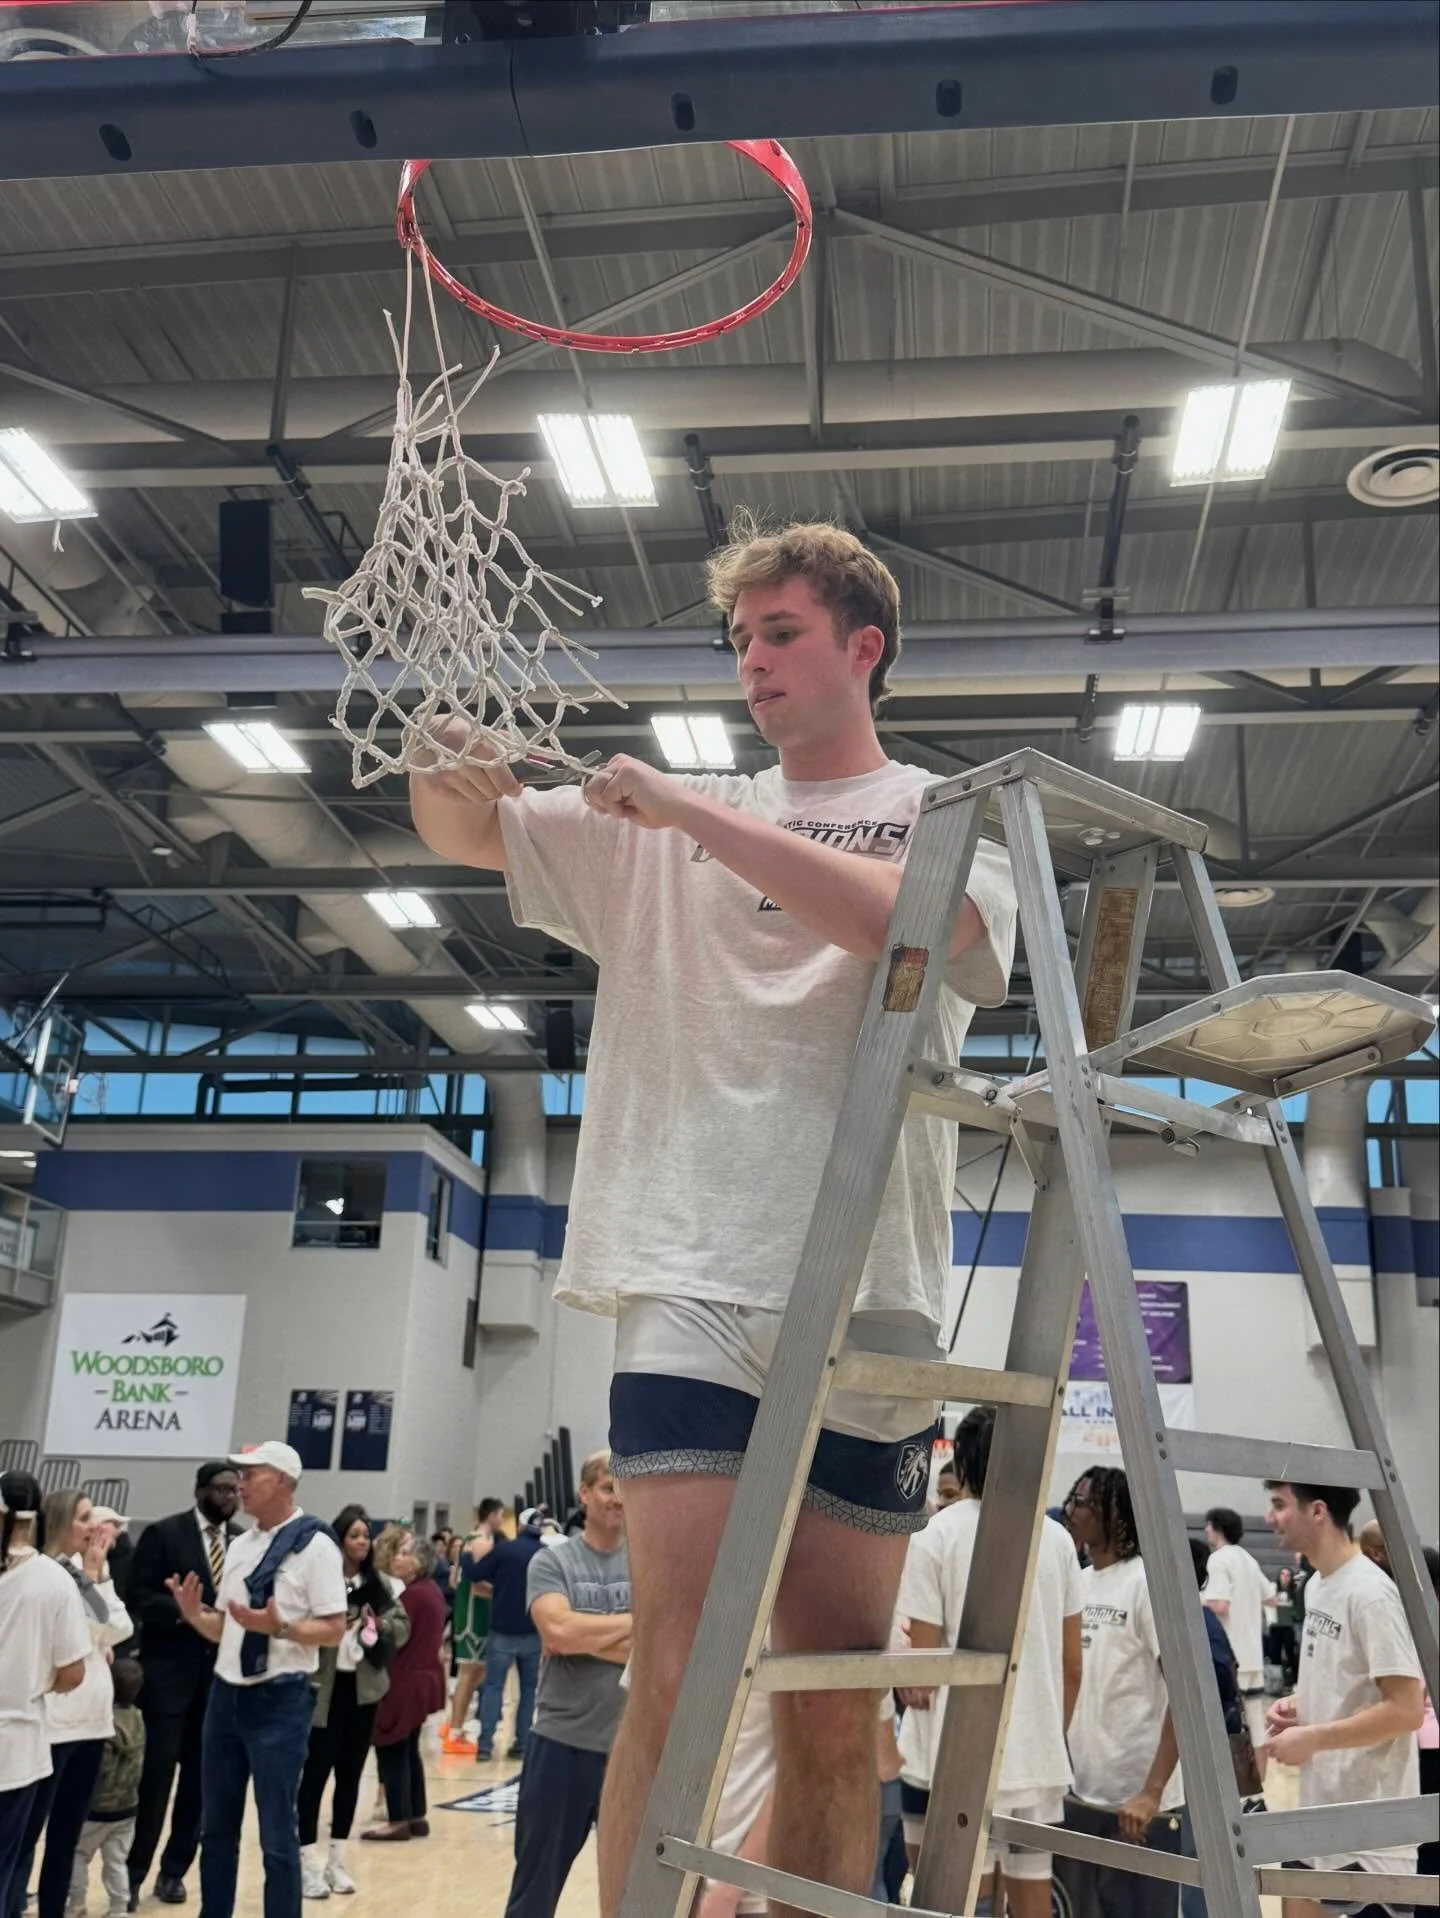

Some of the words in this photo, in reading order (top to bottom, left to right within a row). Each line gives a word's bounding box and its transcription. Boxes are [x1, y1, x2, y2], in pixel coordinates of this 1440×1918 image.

[807, 819, 879, 831] CONFERENCE
[71, 1350, 224, 1376] WOODSBORO
[111, 1379, 171, 1402] BANK
[94, 1407, 182, 1430] ARENA
